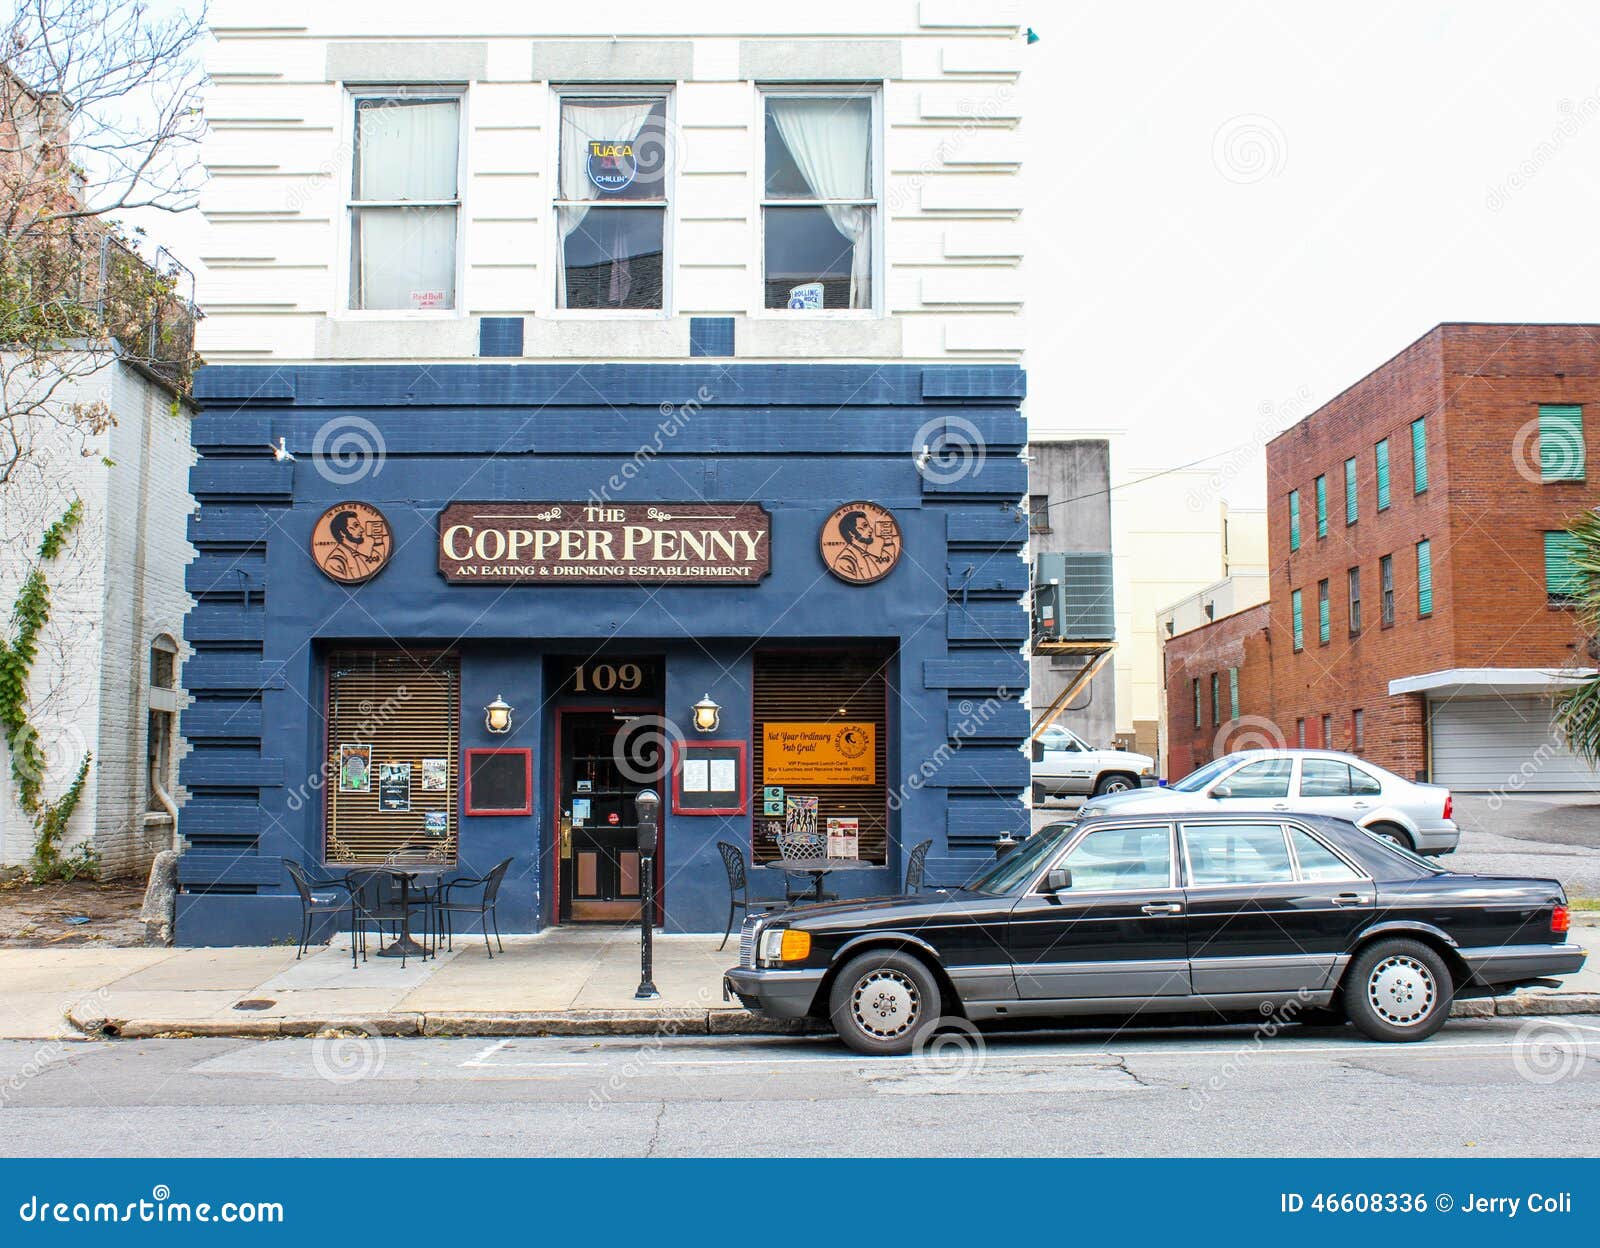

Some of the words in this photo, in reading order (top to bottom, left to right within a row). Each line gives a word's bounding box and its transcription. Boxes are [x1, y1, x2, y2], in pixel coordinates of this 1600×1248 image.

[590, 143, 633, 157] TUACA
[583, 507, 626, 523] THE
[442, 525, 616, 562] COPPER
[622, 526, 767, 562] PENNY
[456, 565, 478, 576] AN
[481, 565, 535, 576] EATING
[539, 565, 550, 576] &
[553, 565, 625, 577] DRINKING
[628, 565, 753, 577] ESTABLISHMENT
[573, 663, 642, 692] 109
[768, 732, 779, 741] Not
[780, 731, 799, 743] Your
[800, 731, 832, 744] Ordinary
[782, 743, 796, 752] Pub
